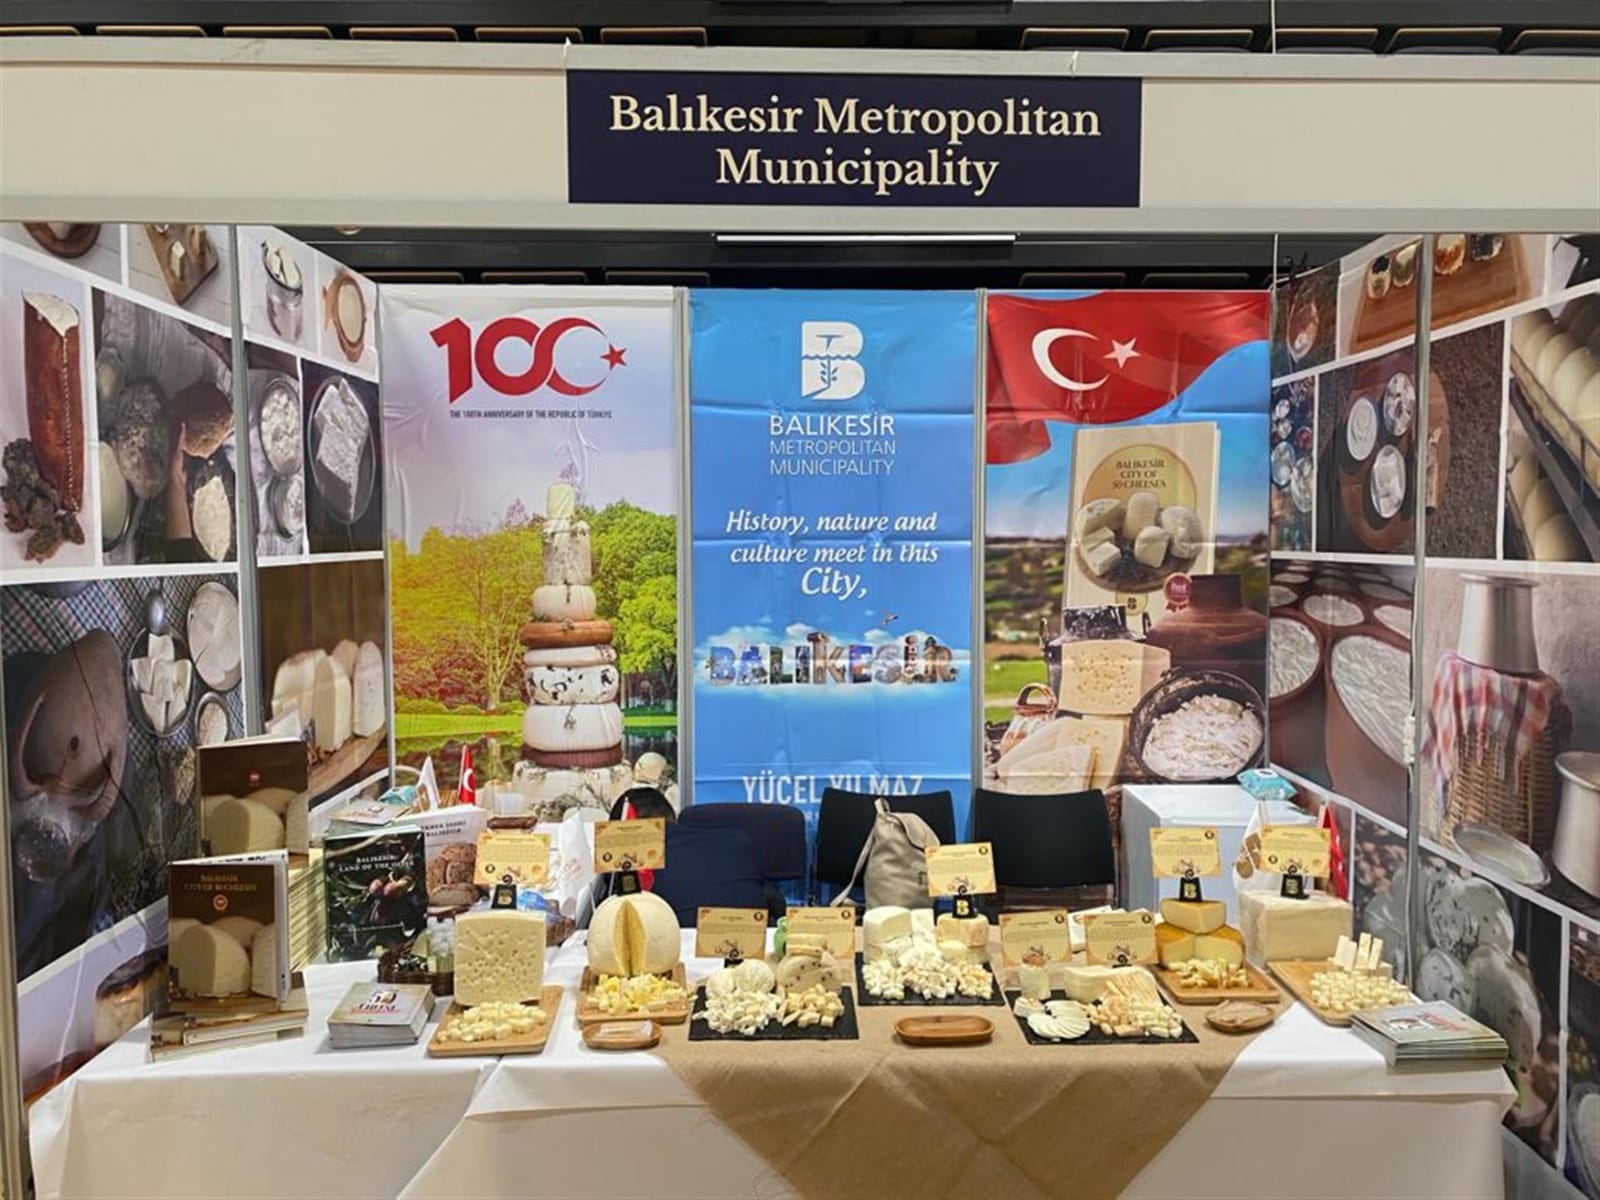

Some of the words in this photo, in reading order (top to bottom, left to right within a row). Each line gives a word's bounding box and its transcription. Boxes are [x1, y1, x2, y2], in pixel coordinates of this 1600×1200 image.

[608, 94, 804, 134] Balıkesir
[813, 97, 1102, 146] Metropolitan
[715, 147, 1000, 197] Municipality
[450, 410, 461, 419] THE
[483, 410, 525, 419] ANNIVERSARY
[525, 410, 533, 419] OF
[534, 410, 546, 419] THE
[547, 410, 576, 419] REPUBLIC
[577, 410, 586, 419] OF
[769, 439, 896, 455] METROPOLITAN
[769, 459, 896, 476] MUNICIPALITY
[725, 509, 810, 536] History,
[816, 513, 889, 532] nature
[894, 512, 938, 532] and
[730, 543, 808, 563] culture
[813, 546, 867, 563] meet
[872, 542, 894, 563] in
[899, 542, 939, 563] this
[801, 566, 868, 601] City,
[743, 770, 822, 804] YÜCEL
